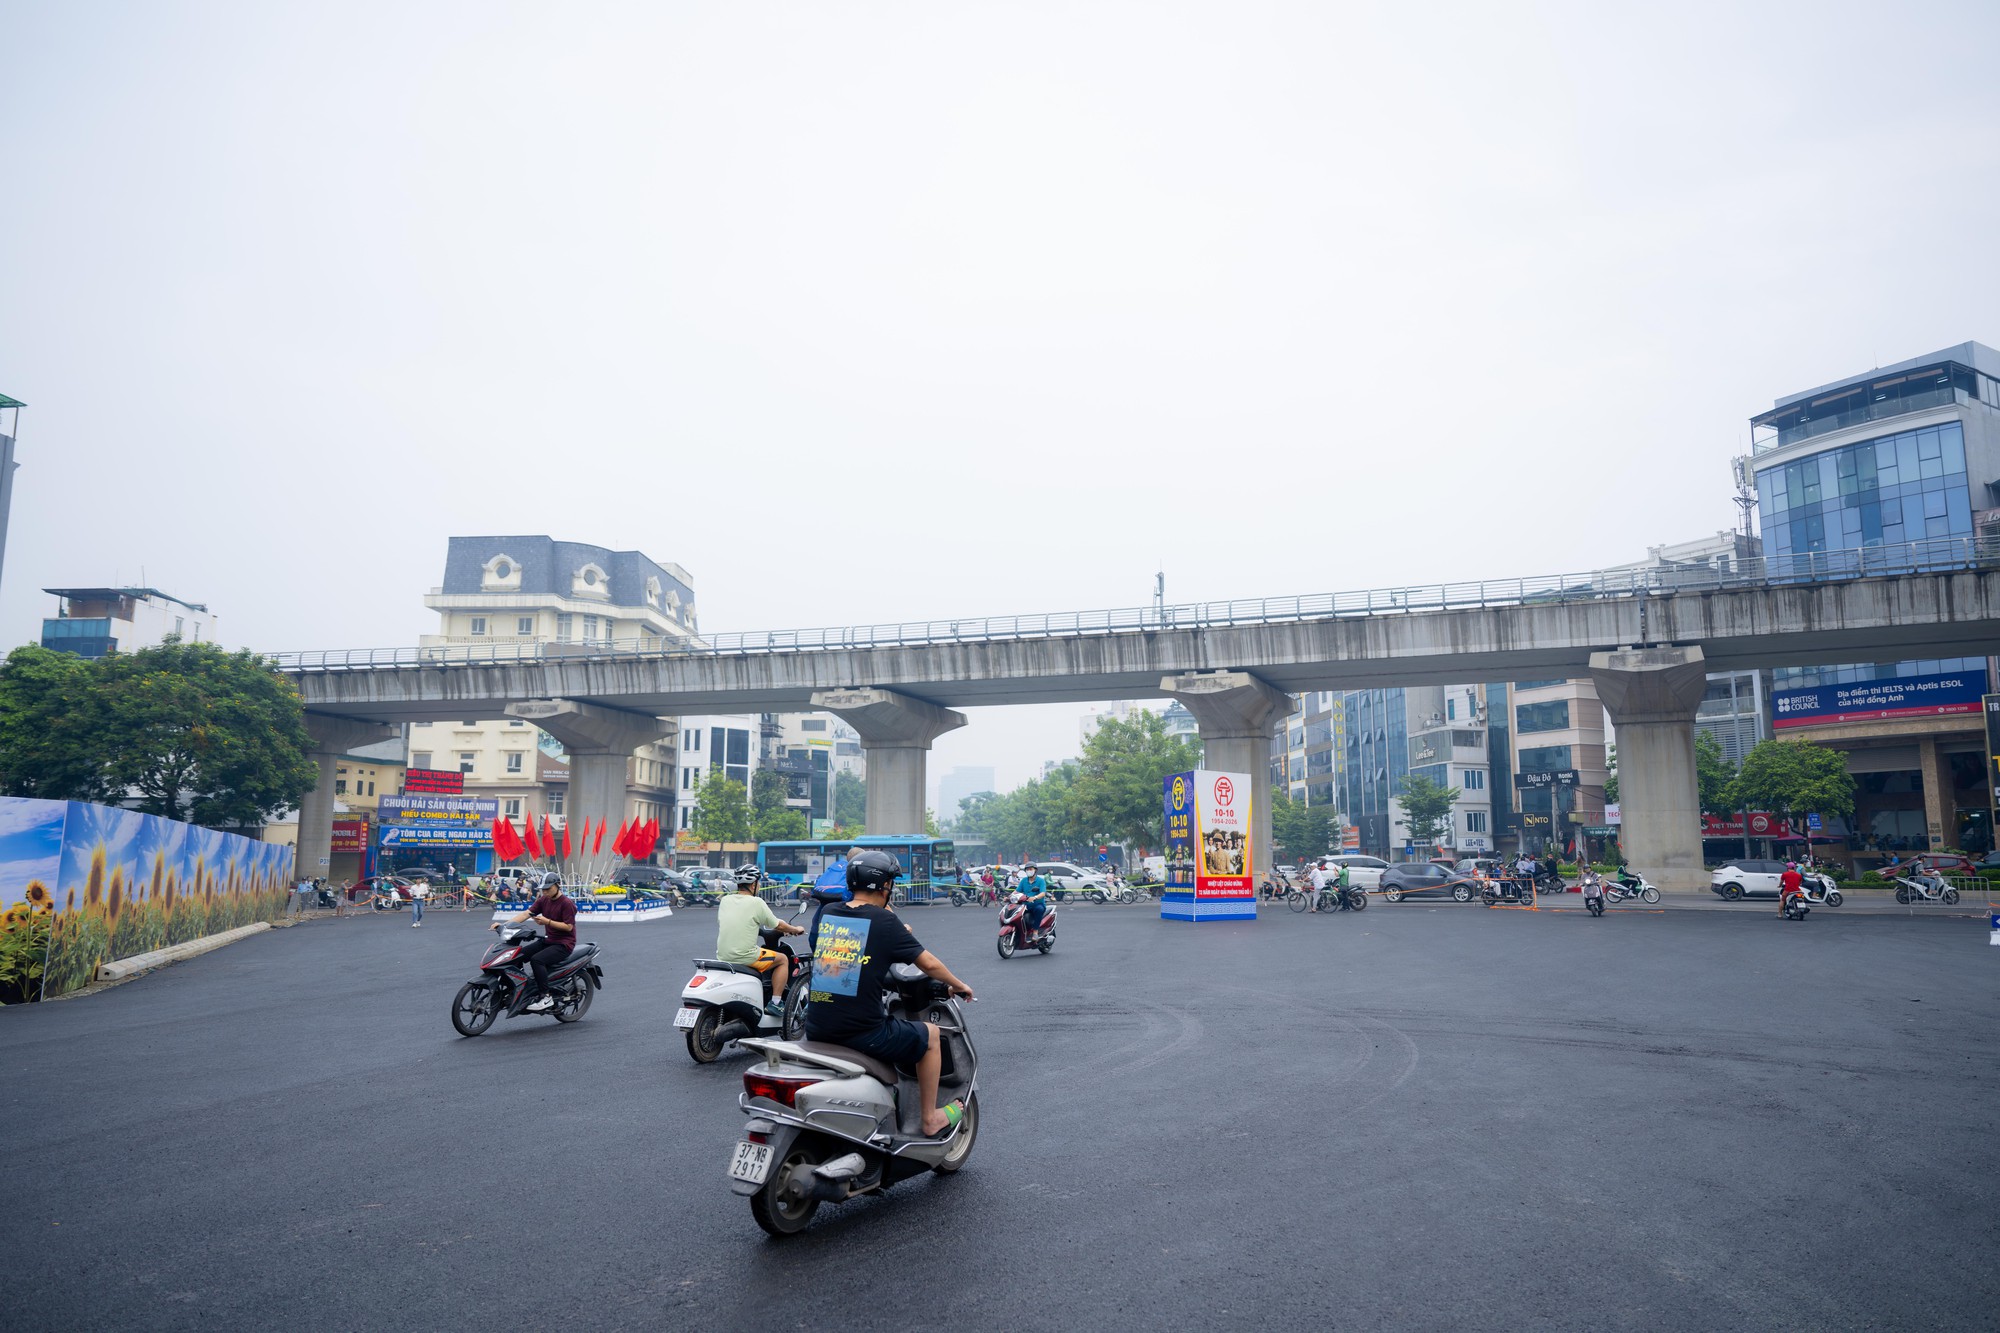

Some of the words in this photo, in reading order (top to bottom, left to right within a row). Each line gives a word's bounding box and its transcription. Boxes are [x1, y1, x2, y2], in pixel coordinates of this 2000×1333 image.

[1837, 690, 1850, 699] Địa
[1851, 687, 1869, 698] điểm
[1870, 685, 1881, 695] thi
[1882, 683, 1904, 694] IELTS
[1905, 682, 1915, 692] và
[1916, 681, 1939, 693] Aptis
[1940, 679, 1963, 689] ESOL
[1790, 695, 1818, 704] BRITISH
[1838, 698, 1851, 707] của
[1852, 696, 1866, 706] Hội
[1866, 695, 1887, 706] đồng
[1888, 694, 1904, 703] Anh
[1791, 701, 1820, 711] COUNCIL
[383, 796, 409, 808] CHUỖI
[411, 797, 426, 809] HẢI
[427, 798, 445, 809] SẢN
[446, 799, 474, 811] QUẢNG
[475, 802, 495, 811] NINH
[420, 811, 448, 819] COMBO
[449, 811, 464, 819] HẢI
[465, 811, 480, 820] SẢN
[1214, 808, 1234, 817] 10-10
[1170, 814, 1188, 828] 10-10
[332, 829, 357, 837] MOBILE
[400, 829, 415, 838] TÔM
[417, 830, 431, 838] CUA
[433, 830, 447, 839] GHẸ
[468, 830, 483, 838] HÀU
[836, 926, 849, 936] PM
[821, 949, 858, 962] ANGELES
[858, 955, 872, 965] US
[825, 1098, 866, 1109] LEAD
[733, 1159, 763, 1180] 2912
